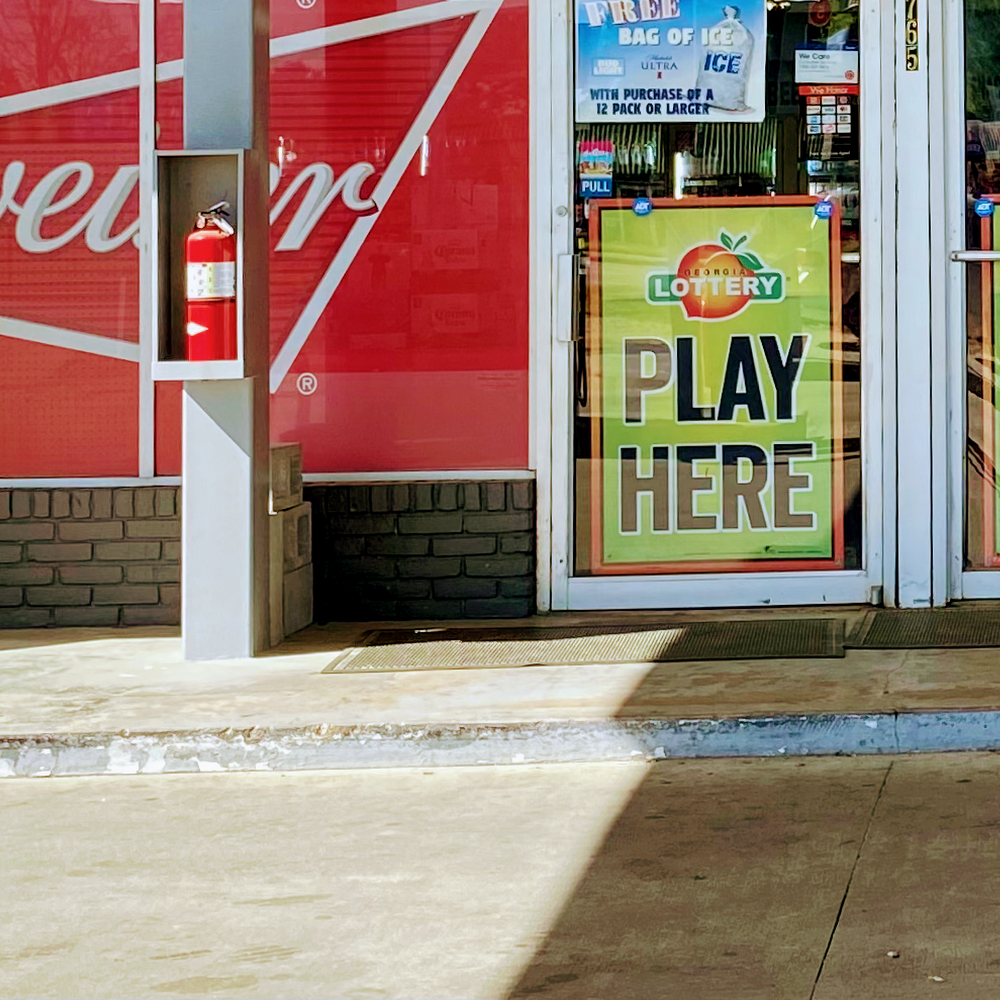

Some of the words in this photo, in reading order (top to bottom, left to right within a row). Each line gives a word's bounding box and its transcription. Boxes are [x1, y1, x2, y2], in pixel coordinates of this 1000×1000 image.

[618, 28, 660, 45] BAG
[667, 28, 694, 45] OF
[701, 28, 733, 46] ICE
[641, 62, 678, 70] ULTRA
[704, 51, 742, 74] ICE
[590, 89, 619, 101] WITH
[624, 89, 683, 101] PURCHASE
[687, 89, 701, 101] OF
[706, 89, 714, 101] A
[596, 103, 608, 115] 12
[612, 103, 641, 115] PACK
[646, 103, 661, 115] OR
[666, 103, 710, 115] LARGER
[581, 181, 610, 192] PULL
[684, 268, 747, 276] GEORGIA
[654, 276, 778, 298] LOTTERY
[624, 335, 809, 423] PLAY
[619, 443, 814, 532] HERE
